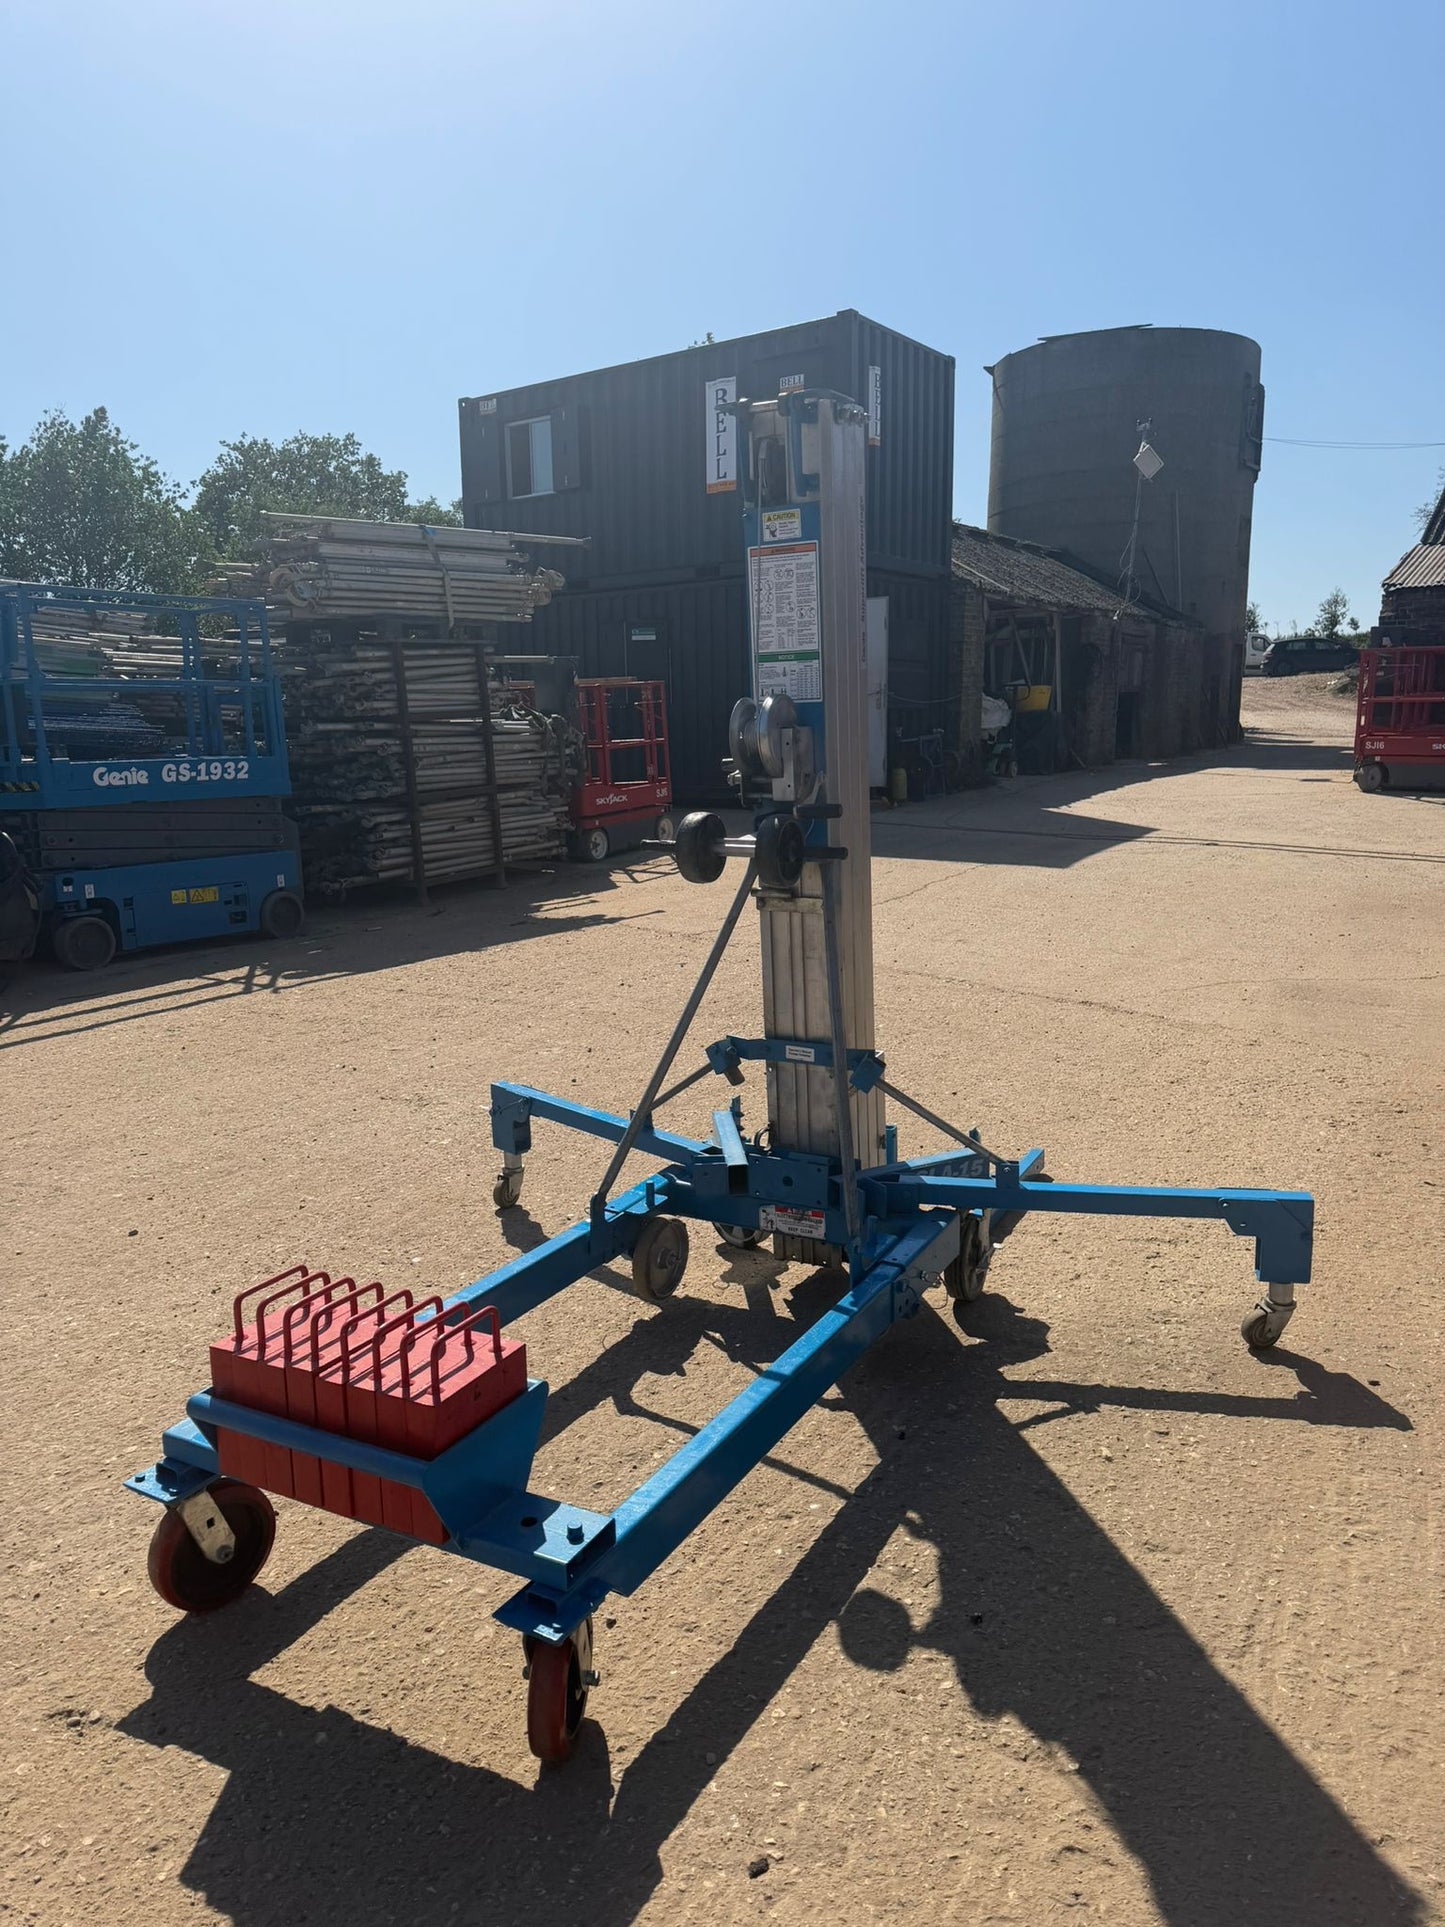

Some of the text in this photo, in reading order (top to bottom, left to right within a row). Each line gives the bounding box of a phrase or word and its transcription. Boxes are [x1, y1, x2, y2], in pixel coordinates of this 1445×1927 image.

[781, 377, 803, 388] BELL
[93, 766, 149, 786] Genie
[161, 761, 249, 782] GS-1932
[596, 793, 628, 806] SKYJACK
